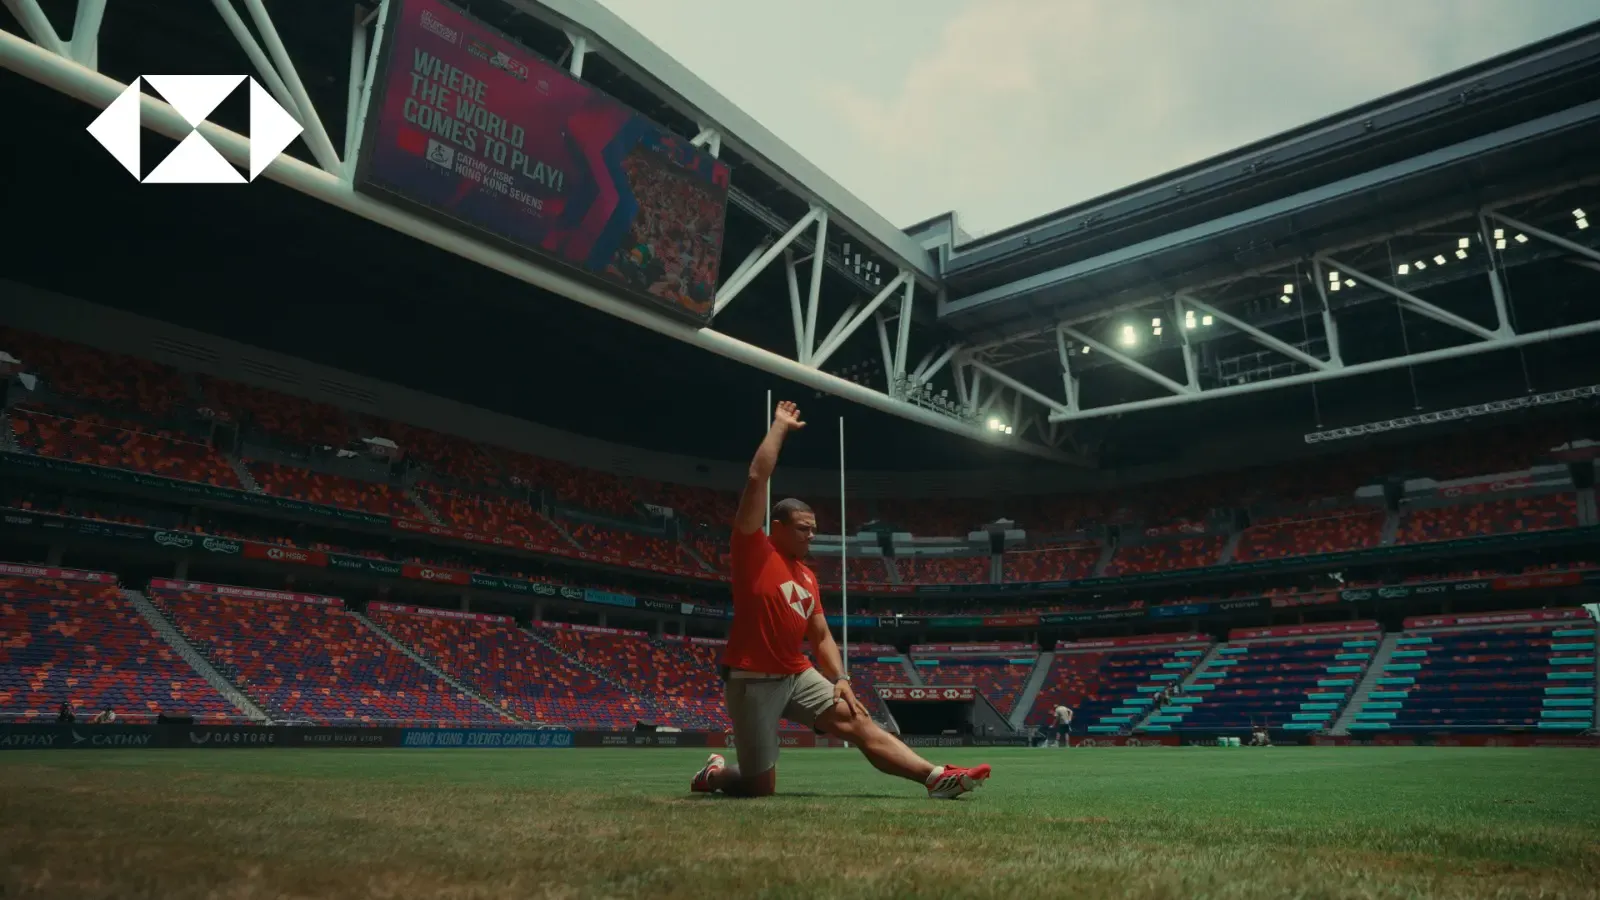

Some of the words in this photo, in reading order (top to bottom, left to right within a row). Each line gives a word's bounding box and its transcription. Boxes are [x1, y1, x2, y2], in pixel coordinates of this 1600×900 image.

[414, 47, 488, 106] WHERE
[410, 71, 452, 112] THE
[456, 95, 525, 149] WORLD
[403, 97, 478, 153] COMES
[484, 134, 507, 166] TO
[511, 148, 564, 193] PLAY!
[454, 162, 482, 182] HONG
[483, 172, 508, 194] KONG
[509, 187, 544, 211] SEVENS
[153, 531, 194, 548] Carlsberg
[202, 536, 240, 554] Carlsberg
[285, 551, 309, 562] HSBC
[1455, 583, 1489, 591] SONY
[0, 734, 58, 746] ATHAY
[91, 733, 153, 746] CATHAY
[214, 732, 276, 743] CASTORE
[405, 731, 436, 746] HONG
[435, 732, 464, 746] KONG
[466, 732, 503, 746] EVENTS
[502, 732, 538, 746] CAPITAL
[539, 733, 551, 746] OF
[552, 733, 572, 746] ASIA
[903, 737, 938, 746] MARRIOTT
